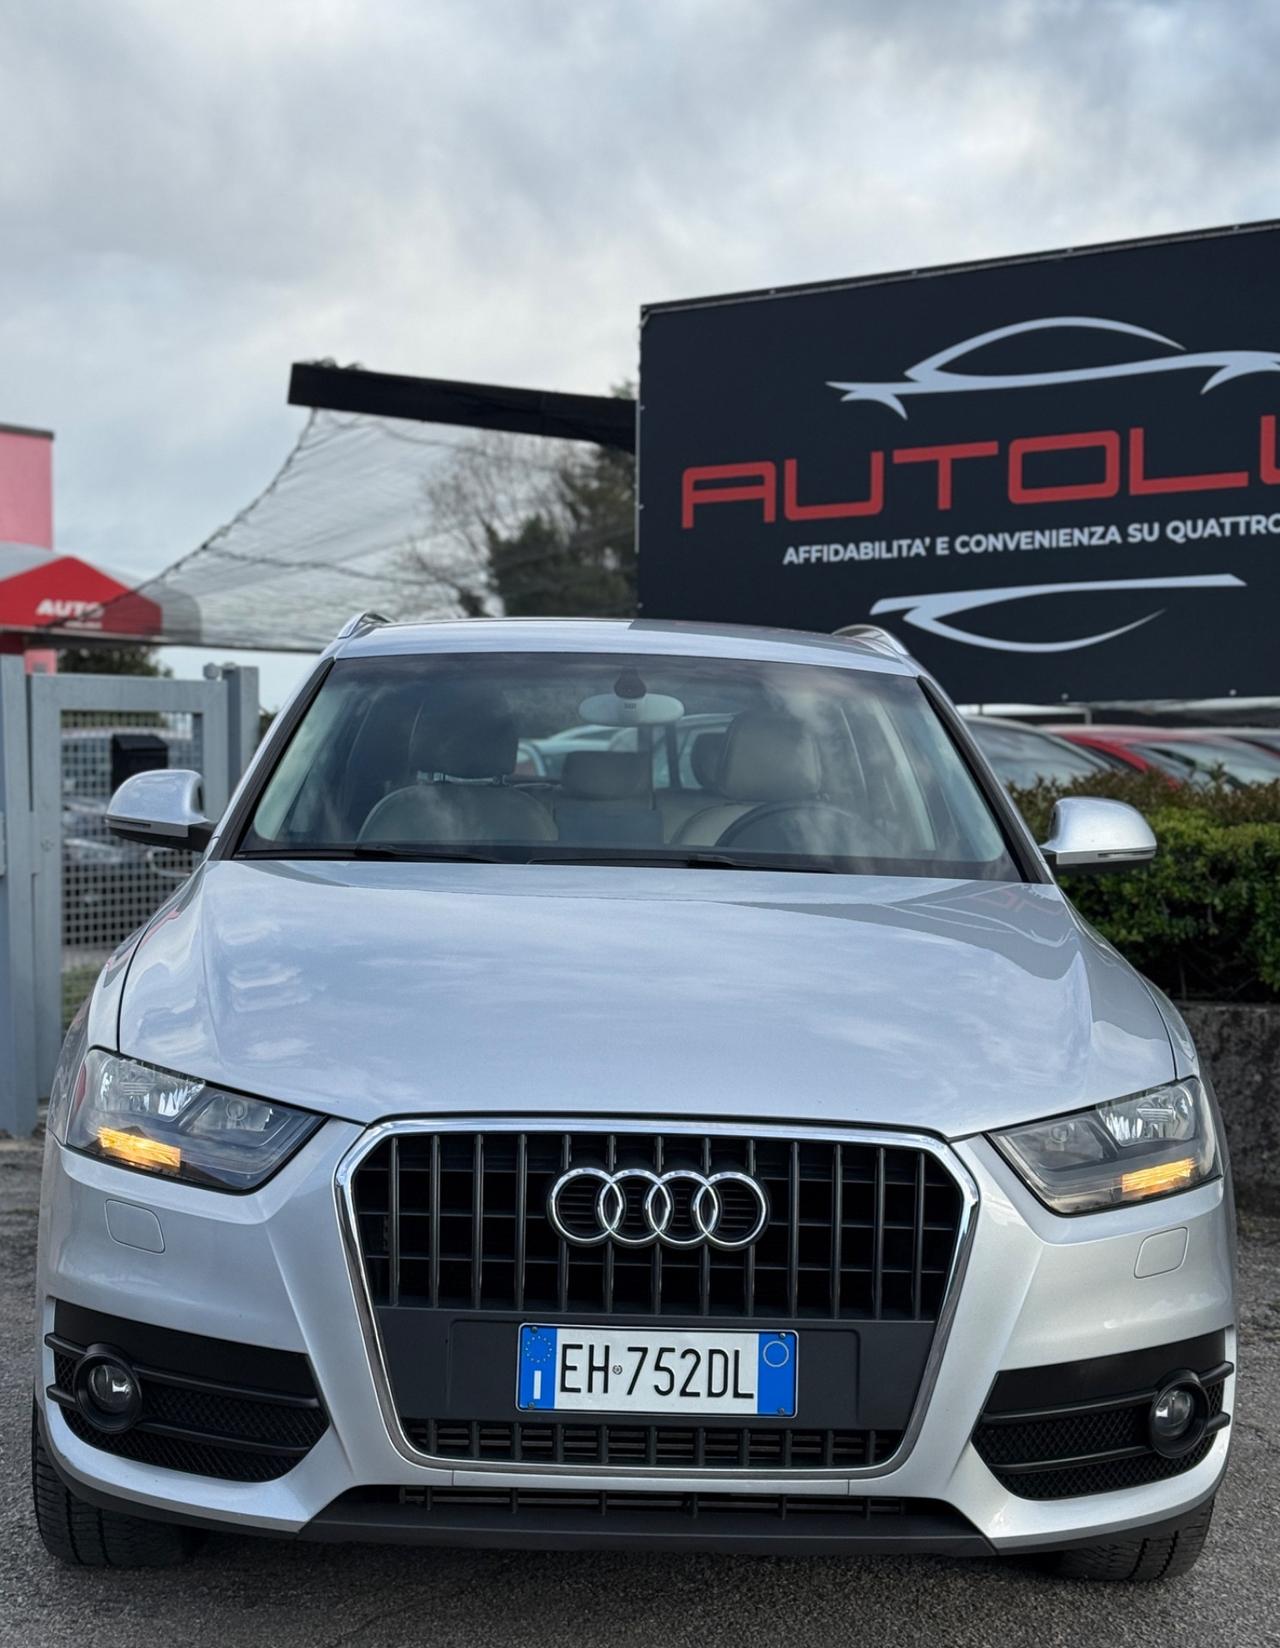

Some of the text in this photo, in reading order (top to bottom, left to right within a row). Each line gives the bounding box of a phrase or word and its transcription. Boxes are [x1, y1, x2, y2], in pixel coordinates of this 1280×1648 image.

[681, 415, 1280, 529] AUTOL
[783, 536, 931, 565] AFFIDABILITA'
[935, 536, 950, 556] E
[954, 524, 1122, 555] CONVENIENZA
[1127, 521, 1160, 544] SU
[35, 599, 104, 618] AUTO
